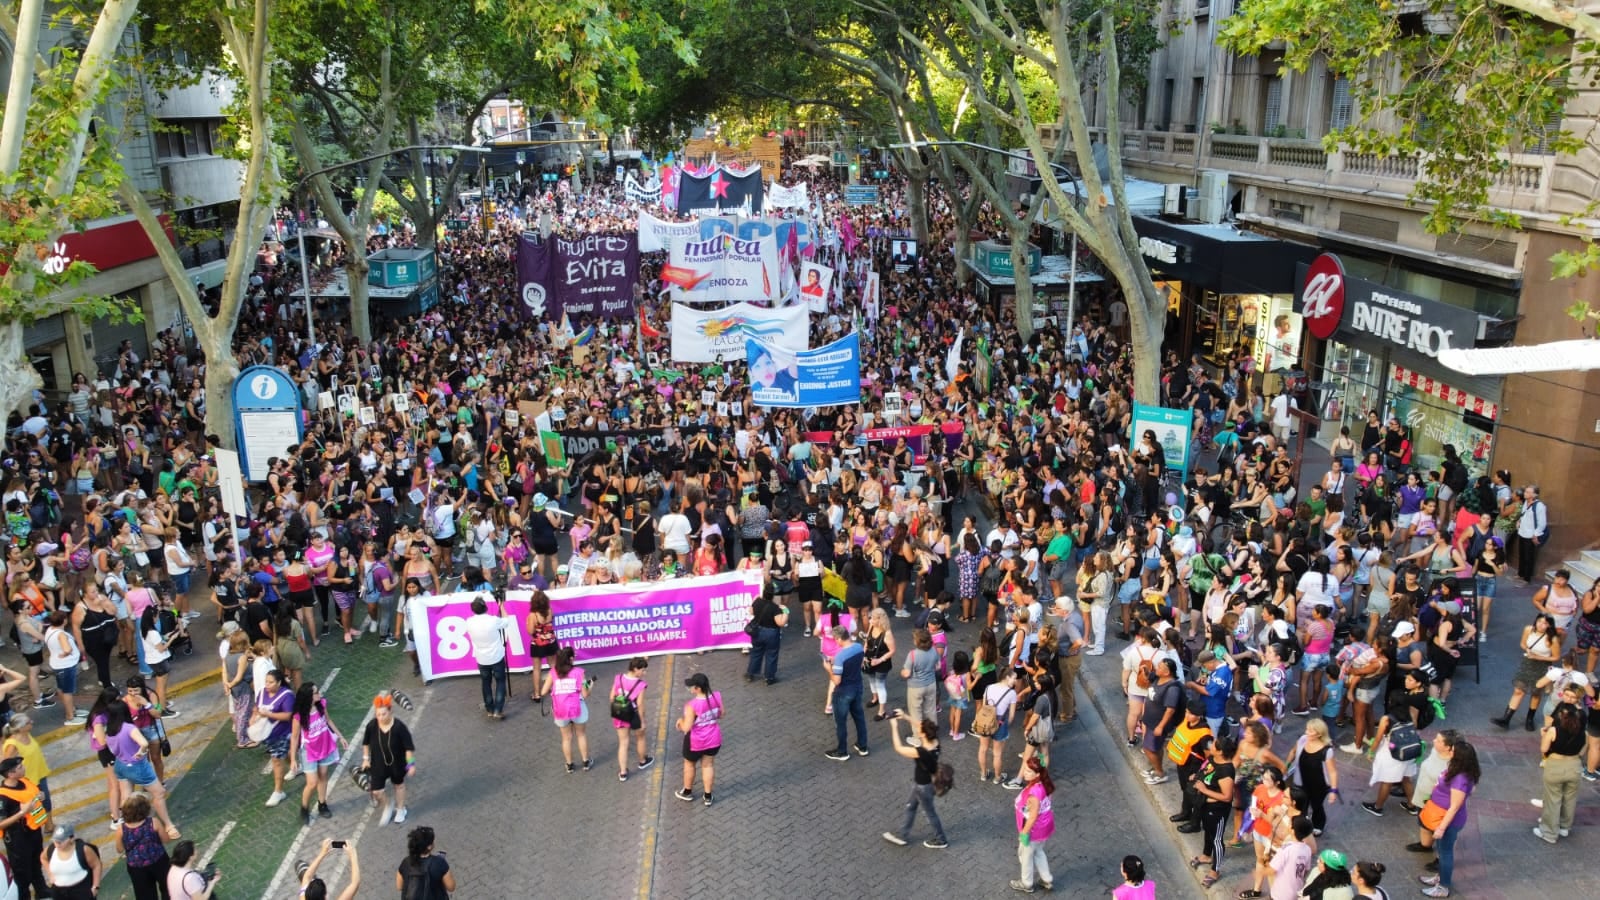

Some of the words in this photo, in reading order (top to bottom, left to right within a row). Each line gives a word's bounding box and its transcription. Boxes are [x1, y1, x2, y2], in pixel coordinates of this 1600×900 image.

[685, 234, 761, 257] marea
[684, 253, 724, 264] FEMINISMO
[728, 255, 762, 263] POPULAR
[565, 256, 627, 285] Evita
[708, 278, 749, 288] ENDOZA
[1255, 301, 1268, 366] STONE
[1352, 301, 1410, 345] ENTRE
[709, 597, 724, 612] NI
[726, 592, 752, 609] UNA
[554, 606, 650, 627] INTERNACIONAL
[652, 605, 668, 619] DE
[670, 603, 692, 616] LAS
[710, 606, 752, 625] MENOS
[554, 628, 585, 640] ERES
[586, 618, 681, 637] TRABAJADORAS
[711, 621, 748, 635] MENDOZ
[574, 637, 619, 650] URGENCIA
[622, 635, 633, 645] ES
[635, 634, 645, 644] EL
[647, 630, 687, 643] HAMBRE
